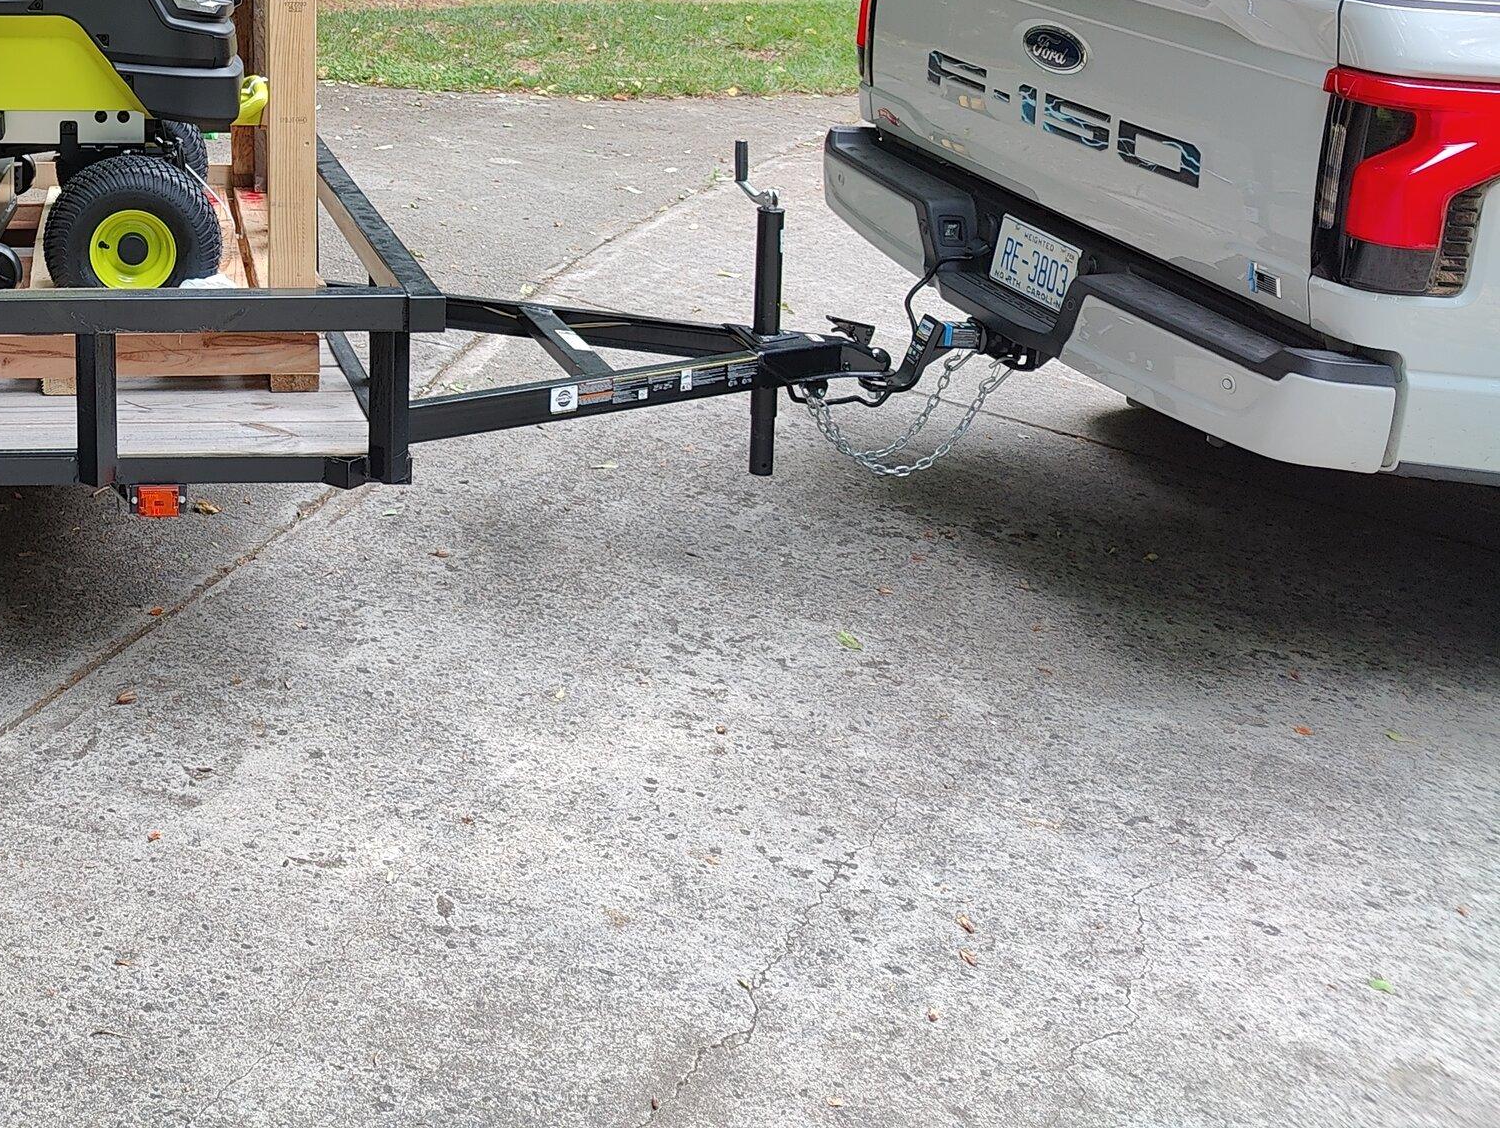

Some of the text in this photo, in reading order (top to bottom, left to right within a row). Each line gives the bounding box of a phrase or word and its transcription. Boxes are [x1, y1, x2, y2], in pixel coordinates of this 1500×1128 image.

[1032, 33, 1067, 66] Ford
[928, 50, 1202, 189] F-150
[1024, 233, 1055, 252] WEIGHTED
[1000, 237, 1069, 298] RE-3803
